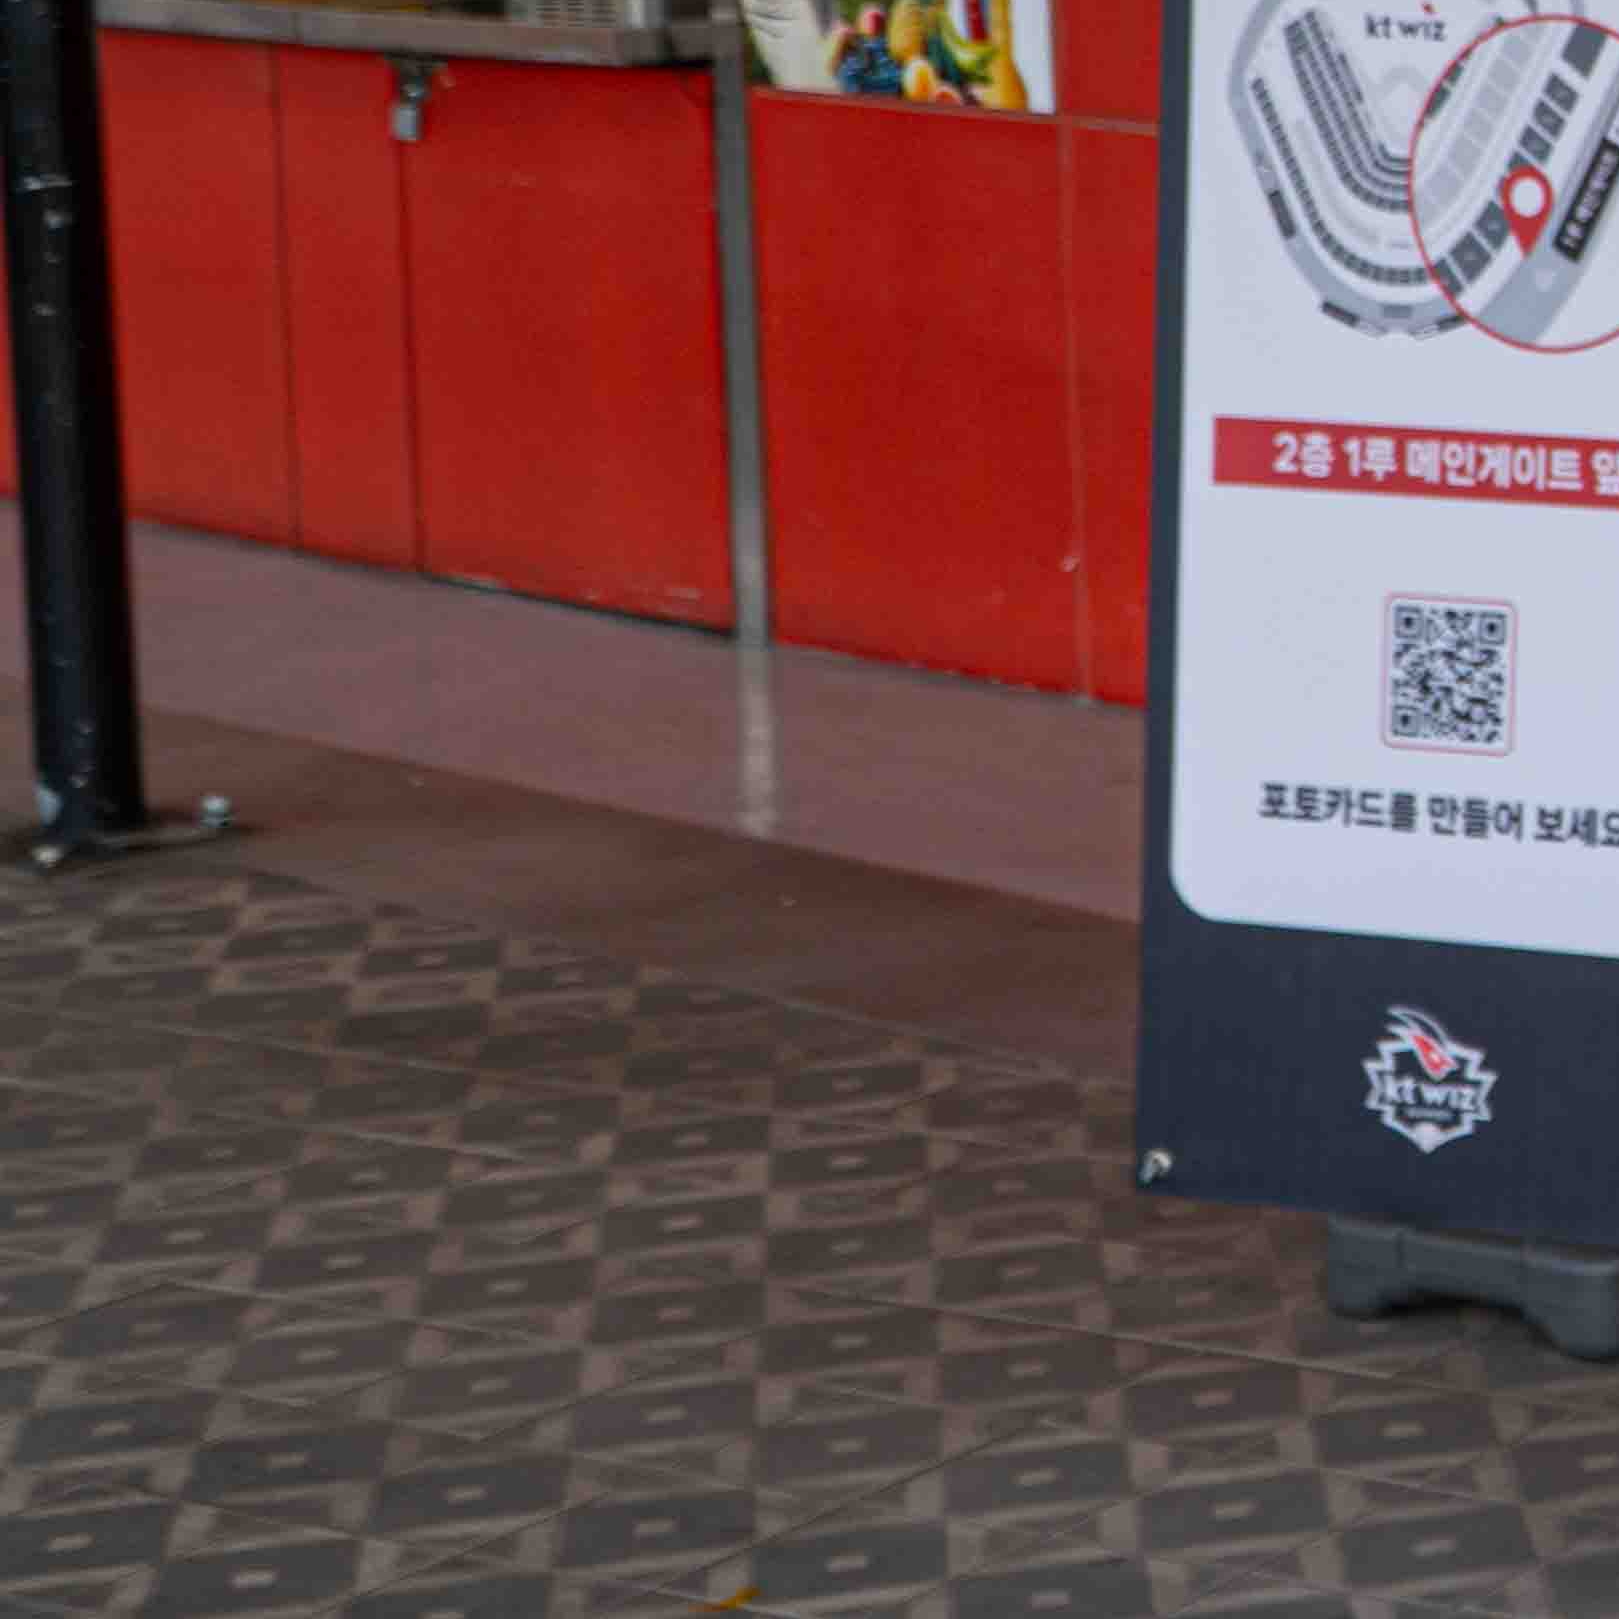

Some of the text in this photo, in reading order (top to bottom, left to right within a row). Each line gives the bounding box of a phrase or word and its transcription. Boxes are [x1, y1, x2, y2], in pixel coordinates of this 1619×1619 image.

[1364, 13, 1446, 42] kt wiz
[1272, 431, 1335, 479] 2층
[1344, 435, 1397, 480] 1루
[1405, 439, 1584, 493] 메인게이트
[1258, 781, 1418, 835] 포토카드를
[1426, 793, 1525, 842] 만들어
